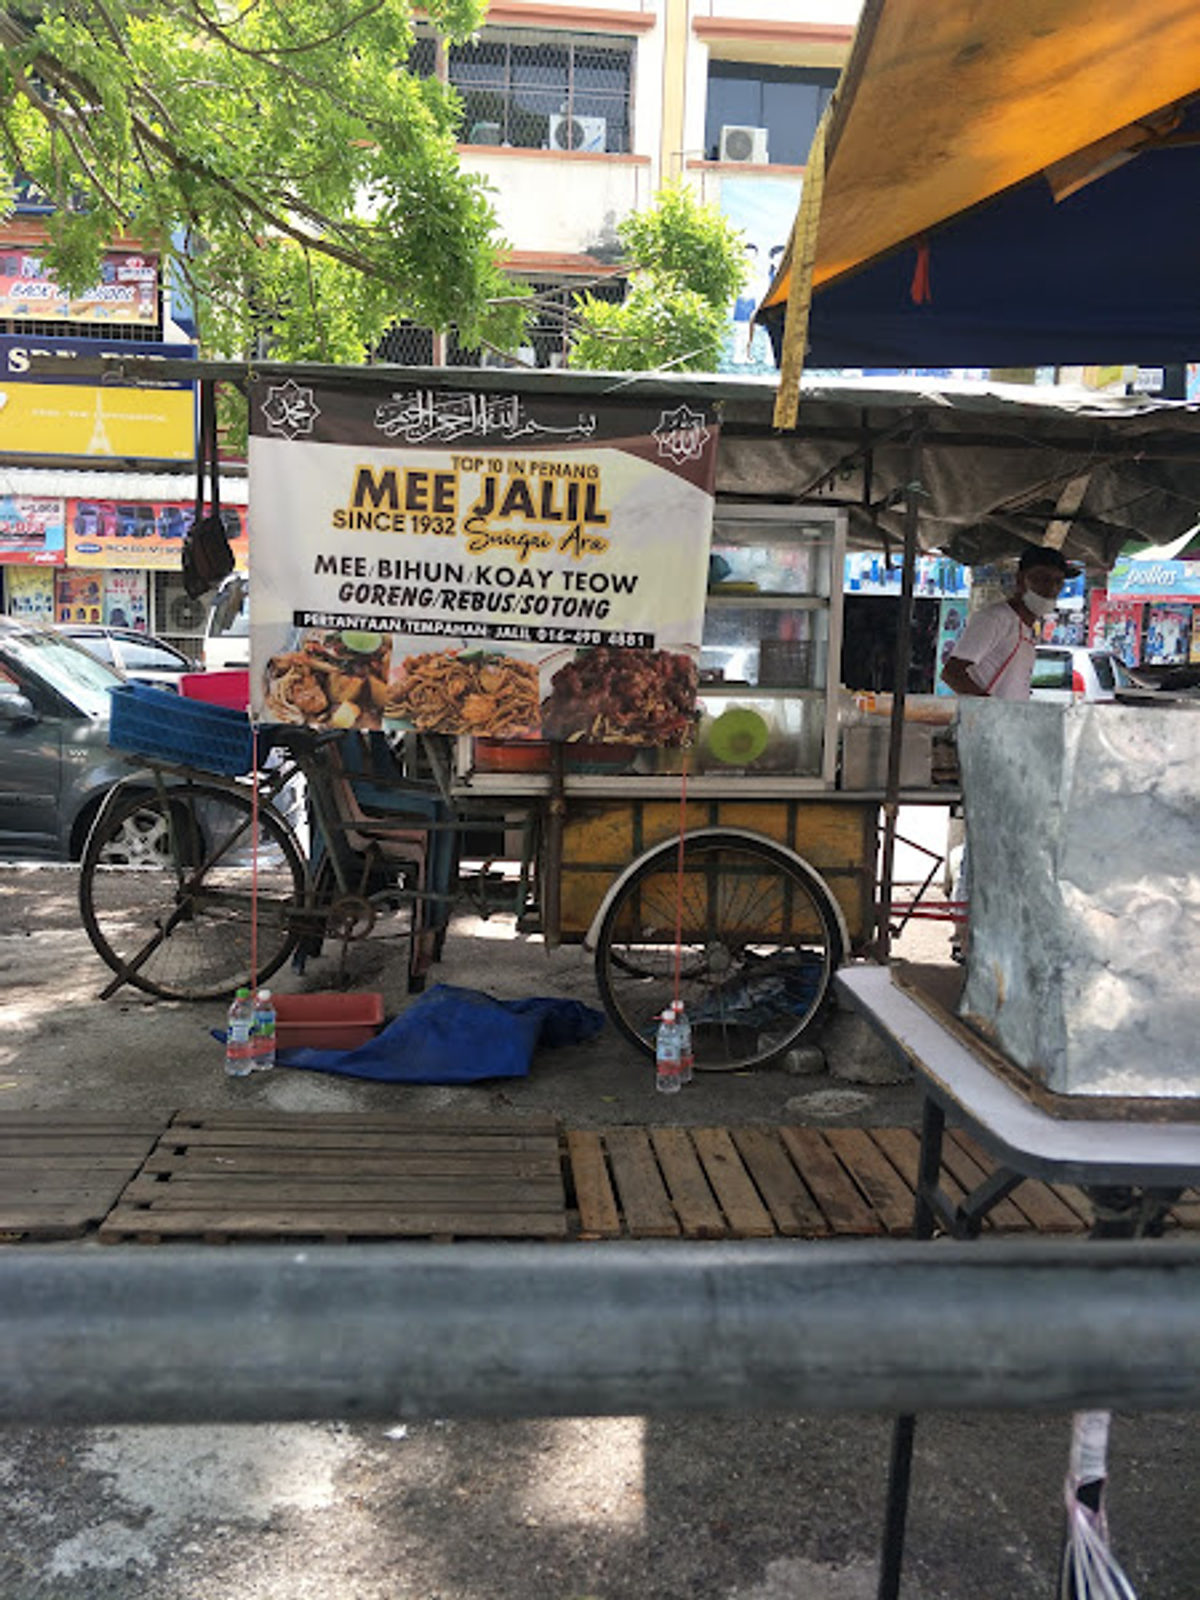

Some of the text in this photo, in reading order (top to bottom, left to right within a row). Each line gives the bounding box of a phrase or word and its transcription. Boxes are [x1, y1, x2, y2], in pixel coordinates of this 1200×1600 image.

[452, 456, 599, 479] TOP 10 IN PENANG
[353, 469, 606, 523] MEE JALIL
[332, 509, 456, 535] SINCE 1932
[562, 571, 639, 595] TEOW
